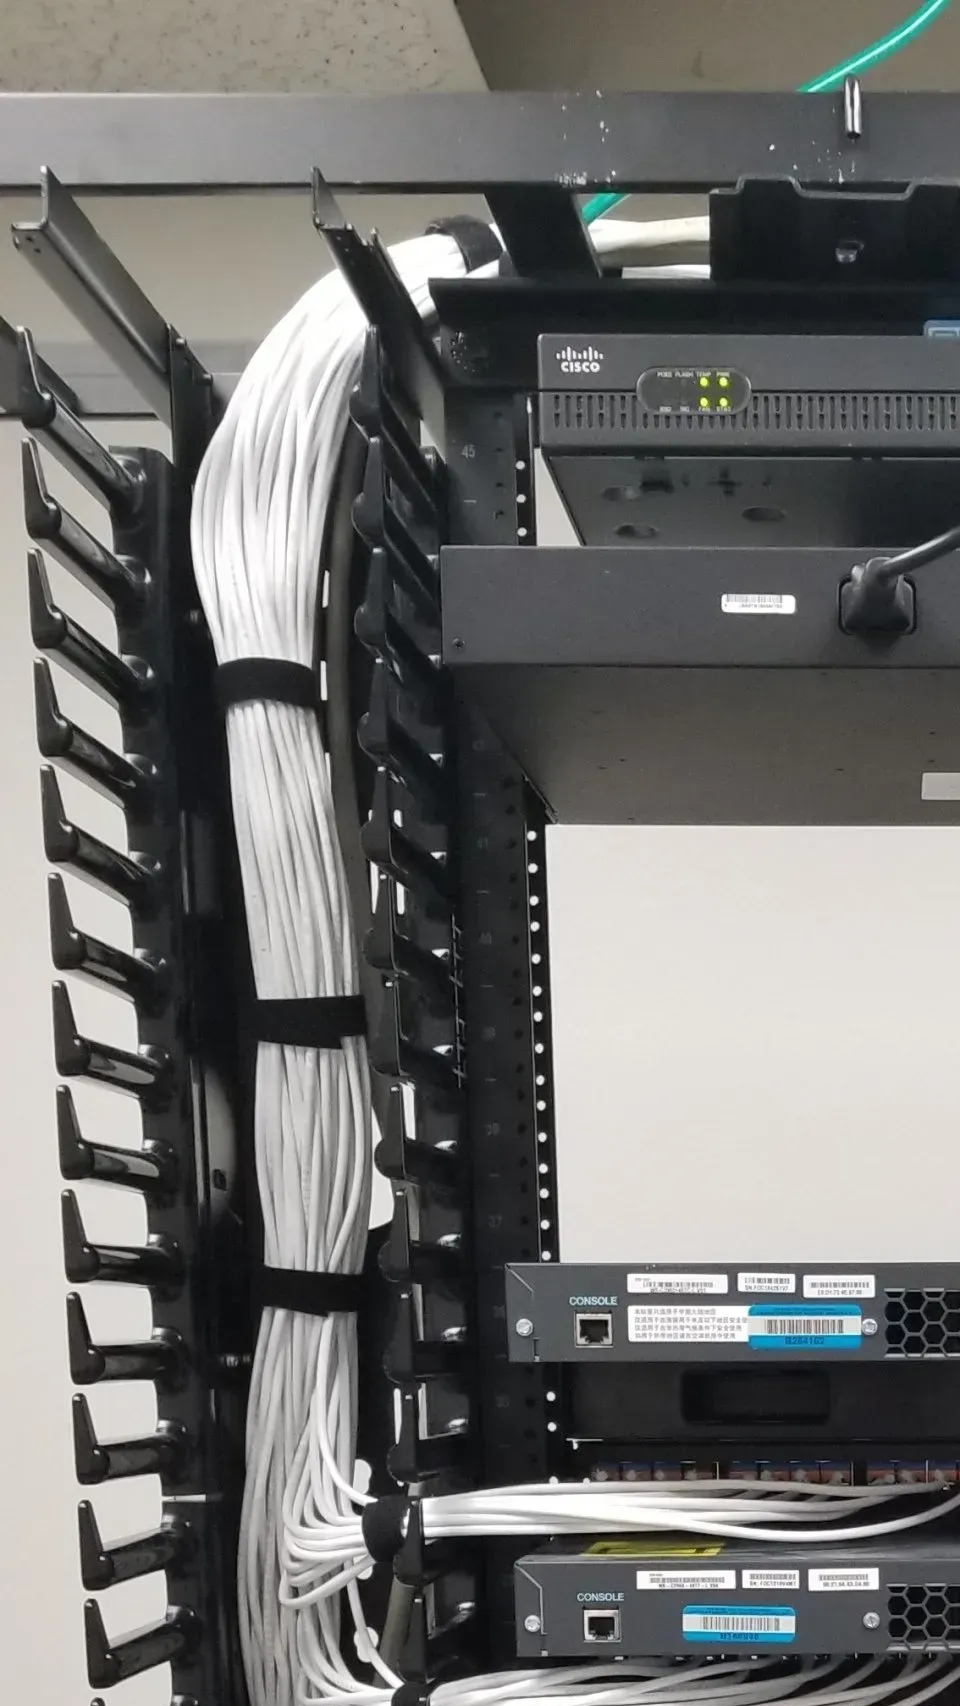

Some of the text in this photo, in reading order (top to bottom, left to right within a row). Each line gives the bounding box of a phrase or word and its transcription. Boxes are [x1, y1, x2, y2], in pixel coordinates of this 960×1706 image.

[561, 361, 600, 373] CISCO
[461, 444, 476, 458] 45
[569, 1296, 618, 1306] CONSOLE
[577, 1592, 625, 1602] CONSOLE
